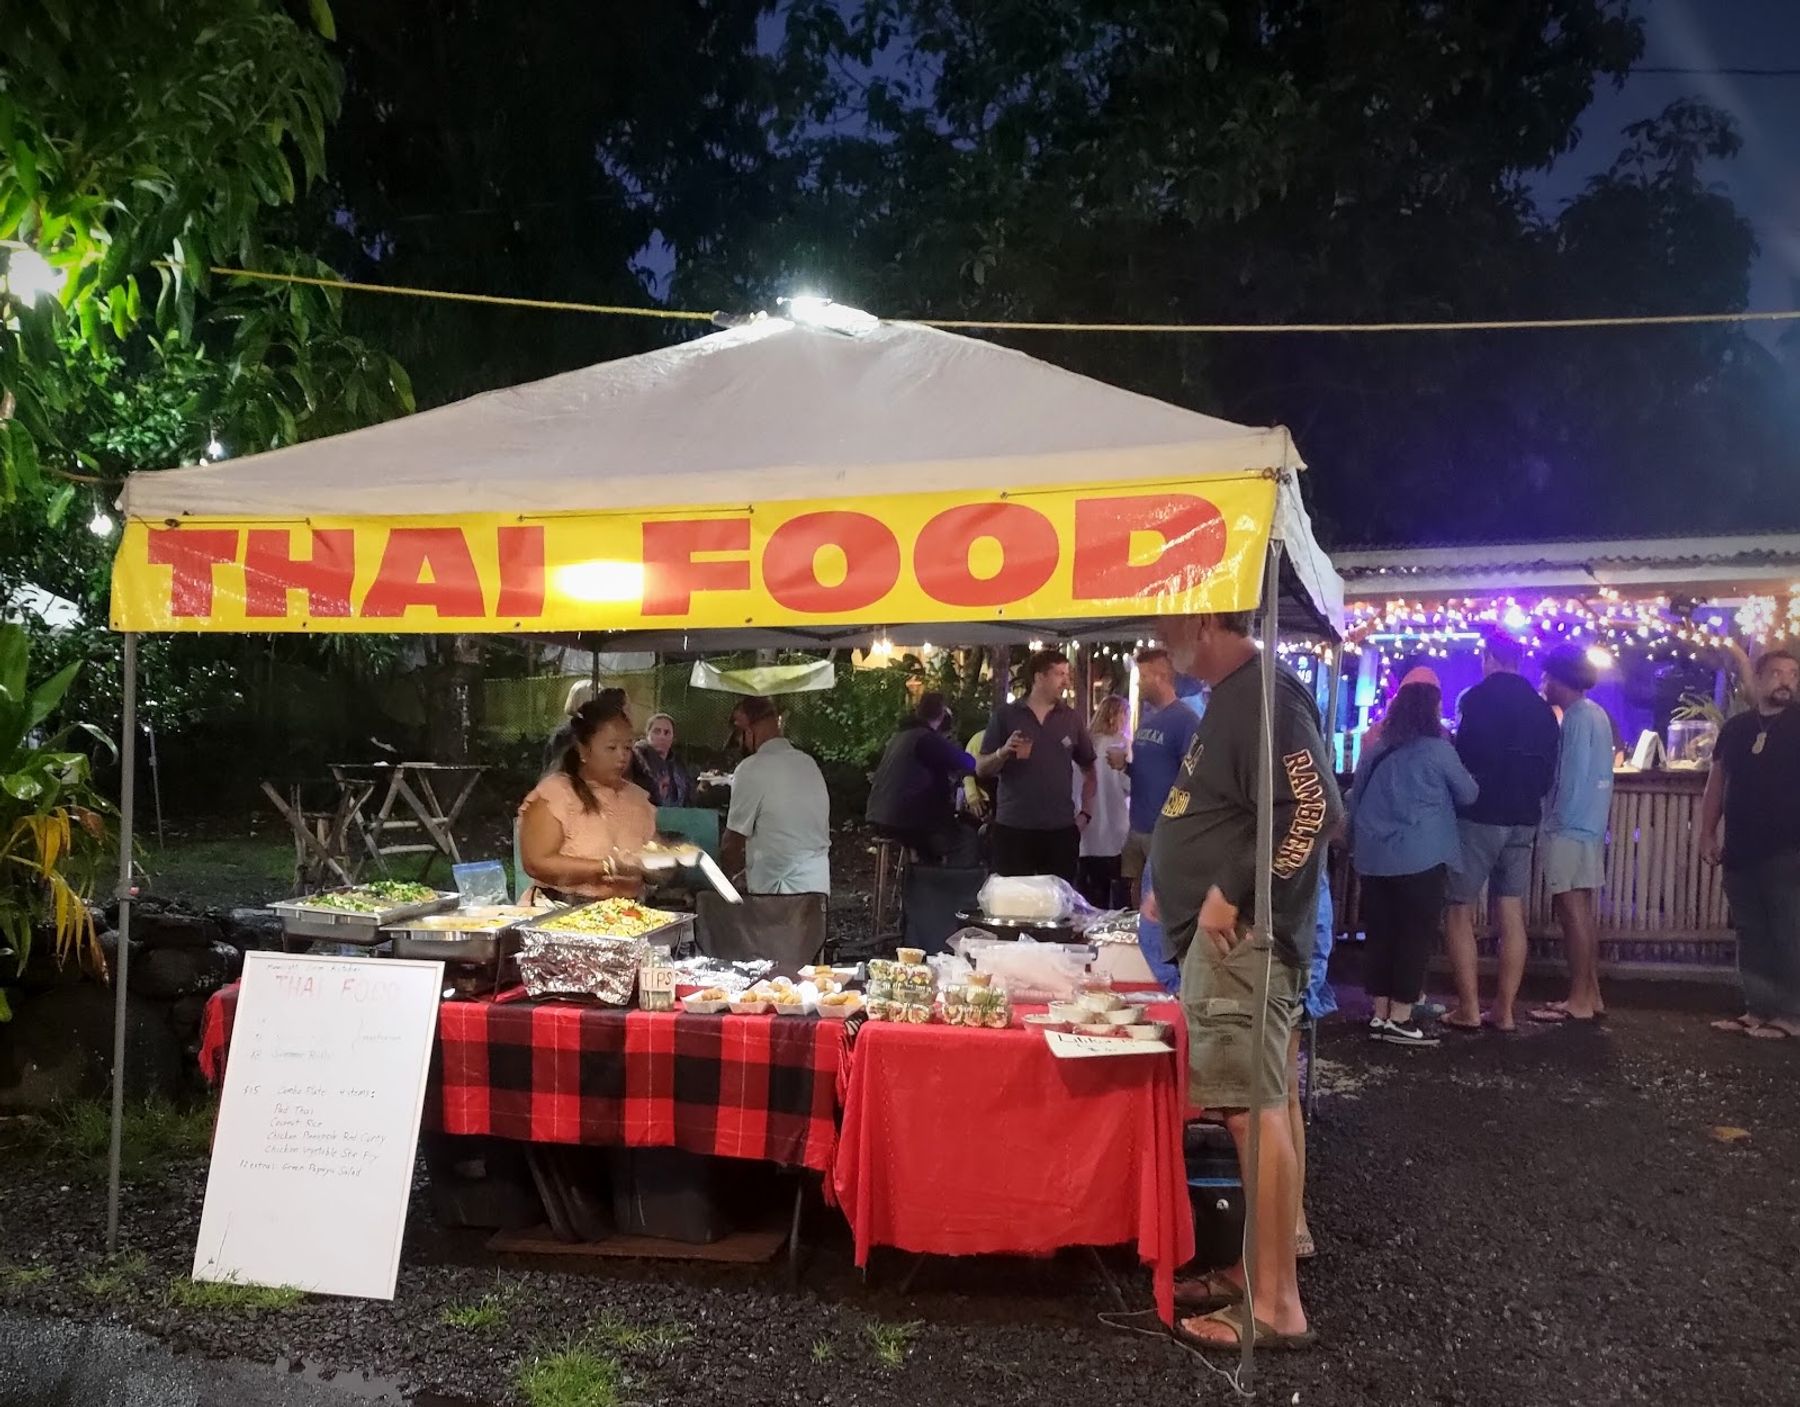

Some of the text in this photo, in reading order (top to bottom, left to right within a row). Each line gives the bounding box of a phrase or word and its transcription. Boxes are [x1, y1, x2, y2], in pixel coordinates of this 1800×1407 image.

[147, 493, 1227, 618] THAI FOOD
[643, 970, 673, 988] TIPS
